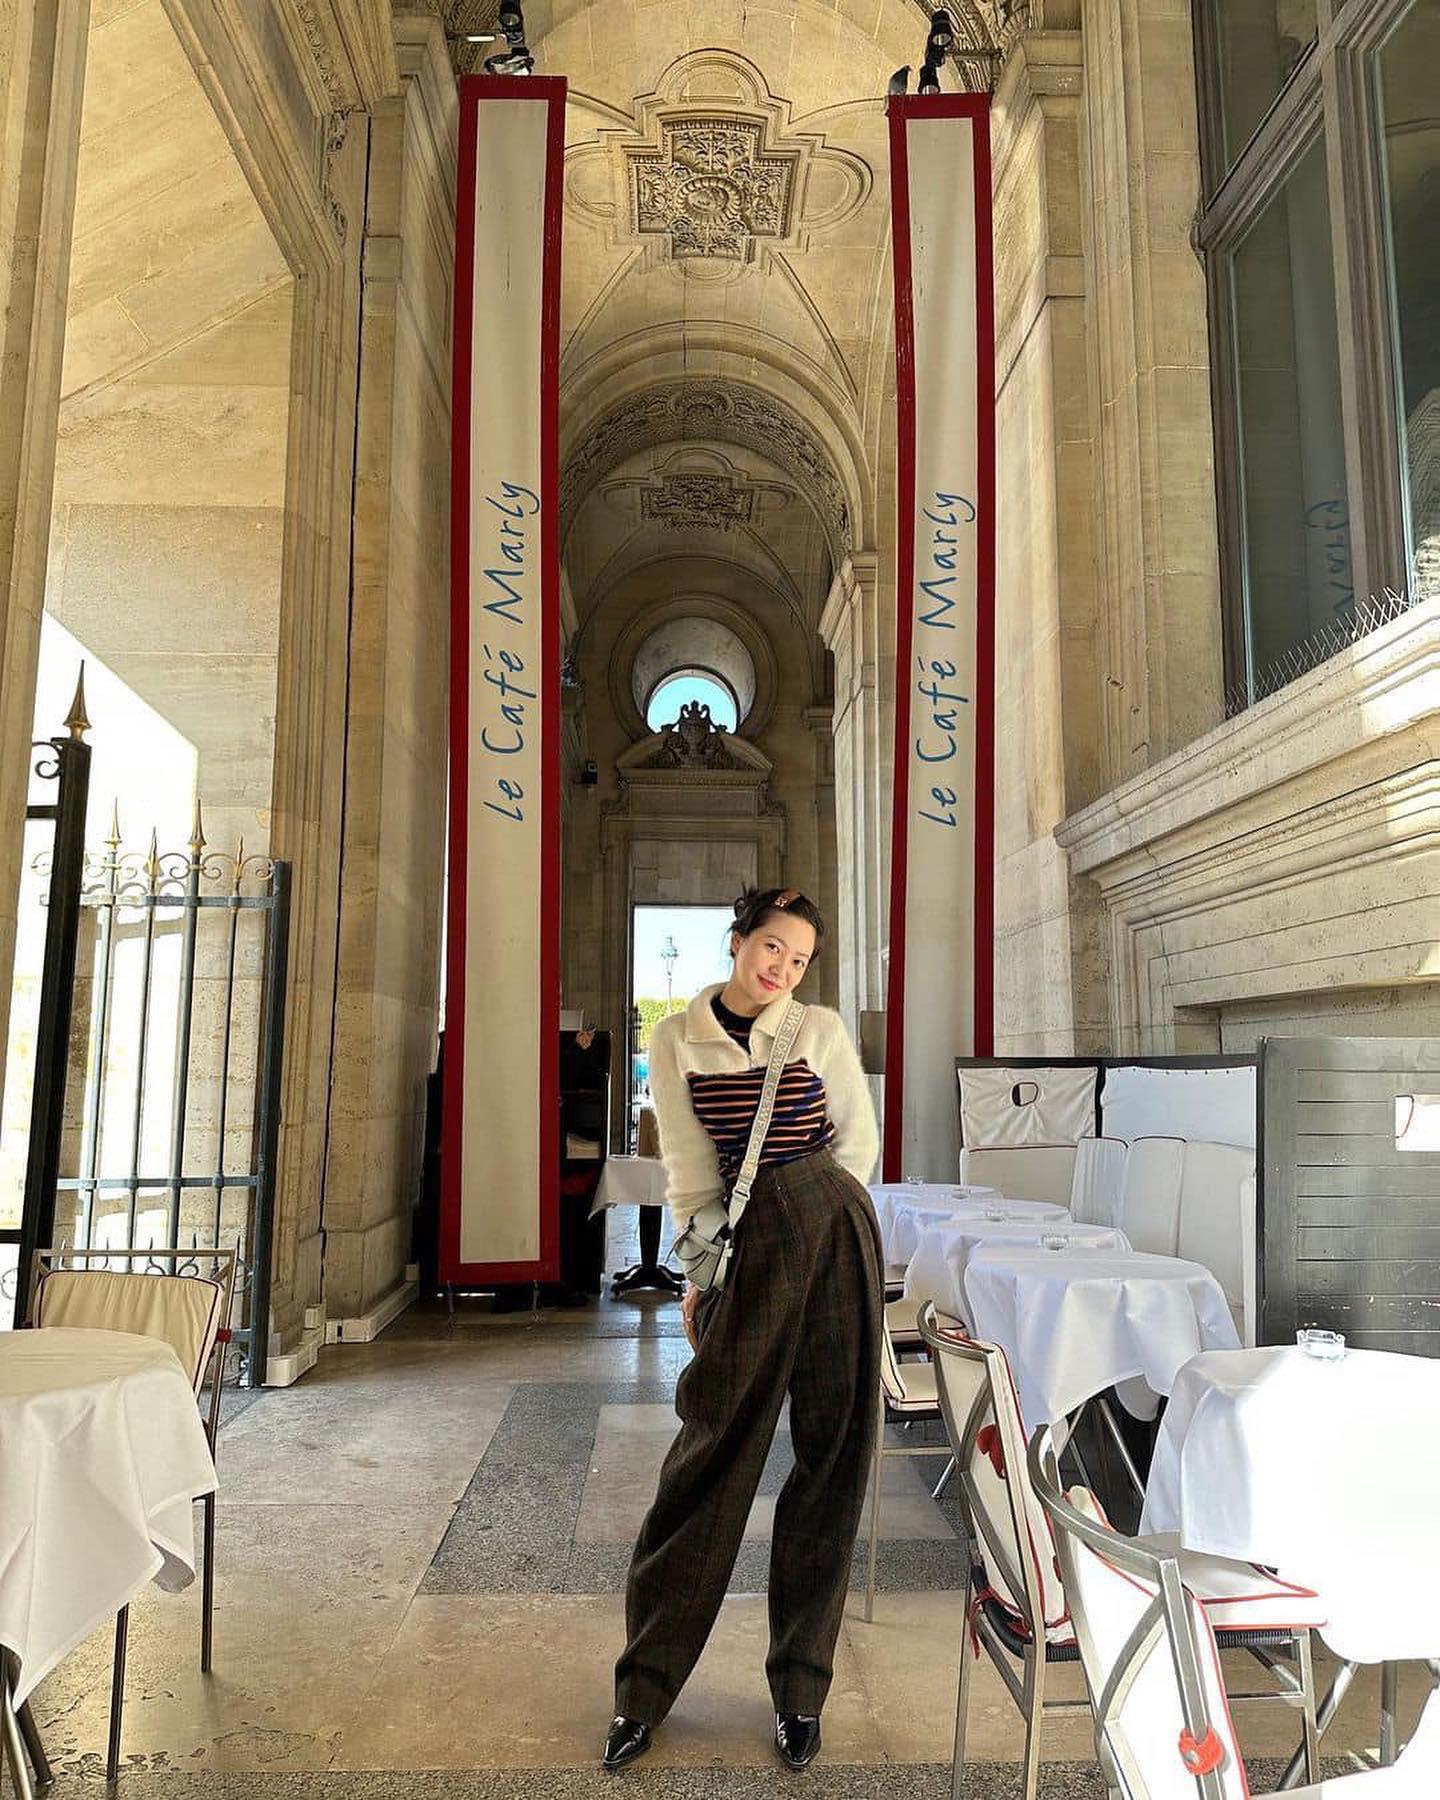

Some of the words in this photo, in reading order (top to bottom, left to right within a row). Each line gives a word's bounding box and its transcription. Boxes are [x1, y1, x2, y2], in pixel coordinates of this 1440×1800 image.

[482, 481, 540, 625] Marly
[917, 492, 975, 629] Marly
[481, 645, 537, 754] Café
[915, 655, 969, 763] Café
[483, 778, 524, 822] Le
[918, 787, 957, 827] Le
